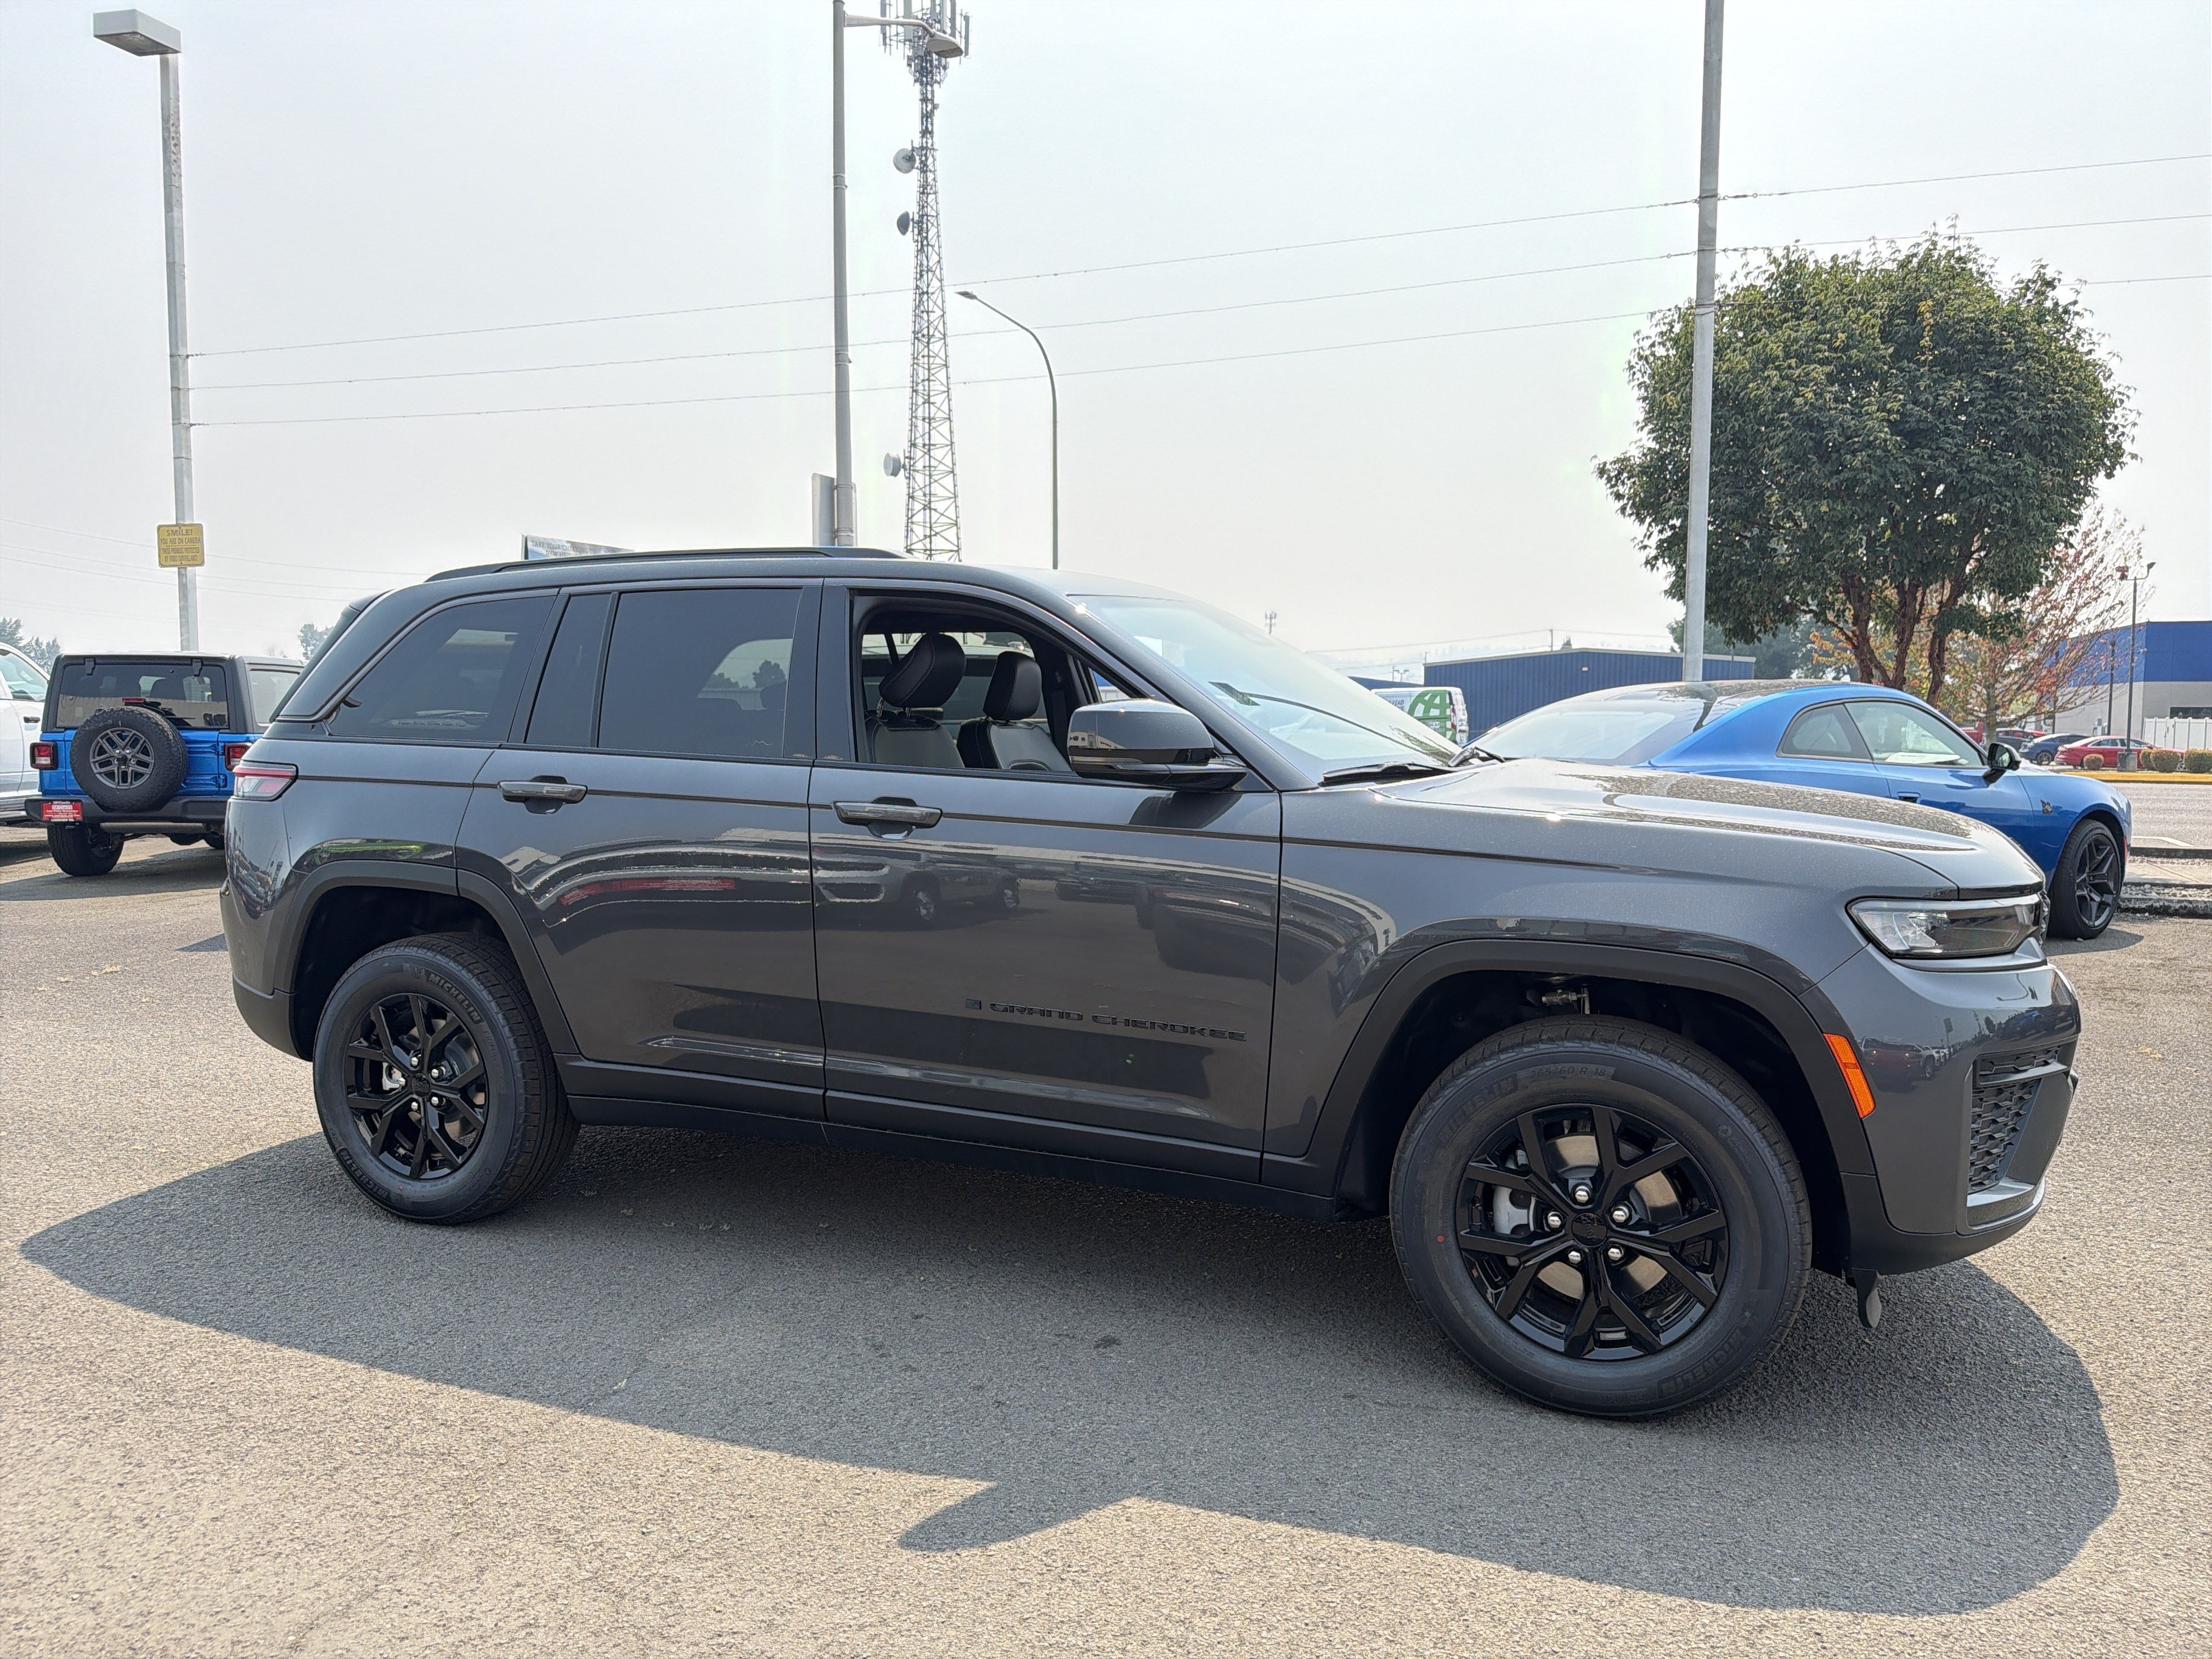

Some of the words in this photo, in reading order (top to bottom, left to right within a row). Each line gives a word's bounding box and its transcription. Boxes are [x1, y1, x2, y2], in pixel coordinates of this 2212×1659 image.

[428, 973, 481, 1022] MICHELIN
[990, 1002, 1083, 1021] GRAND
[1092, 1013, 1247, 1041] CHEROKEE
[1579, 1066, 1588, 1075] R
[1594, 1068, 1606, 1076] 18
[340, 1150, 390, 1198] MICHELIN
[1662, 1327, 1743, 1395] MICHELIN
